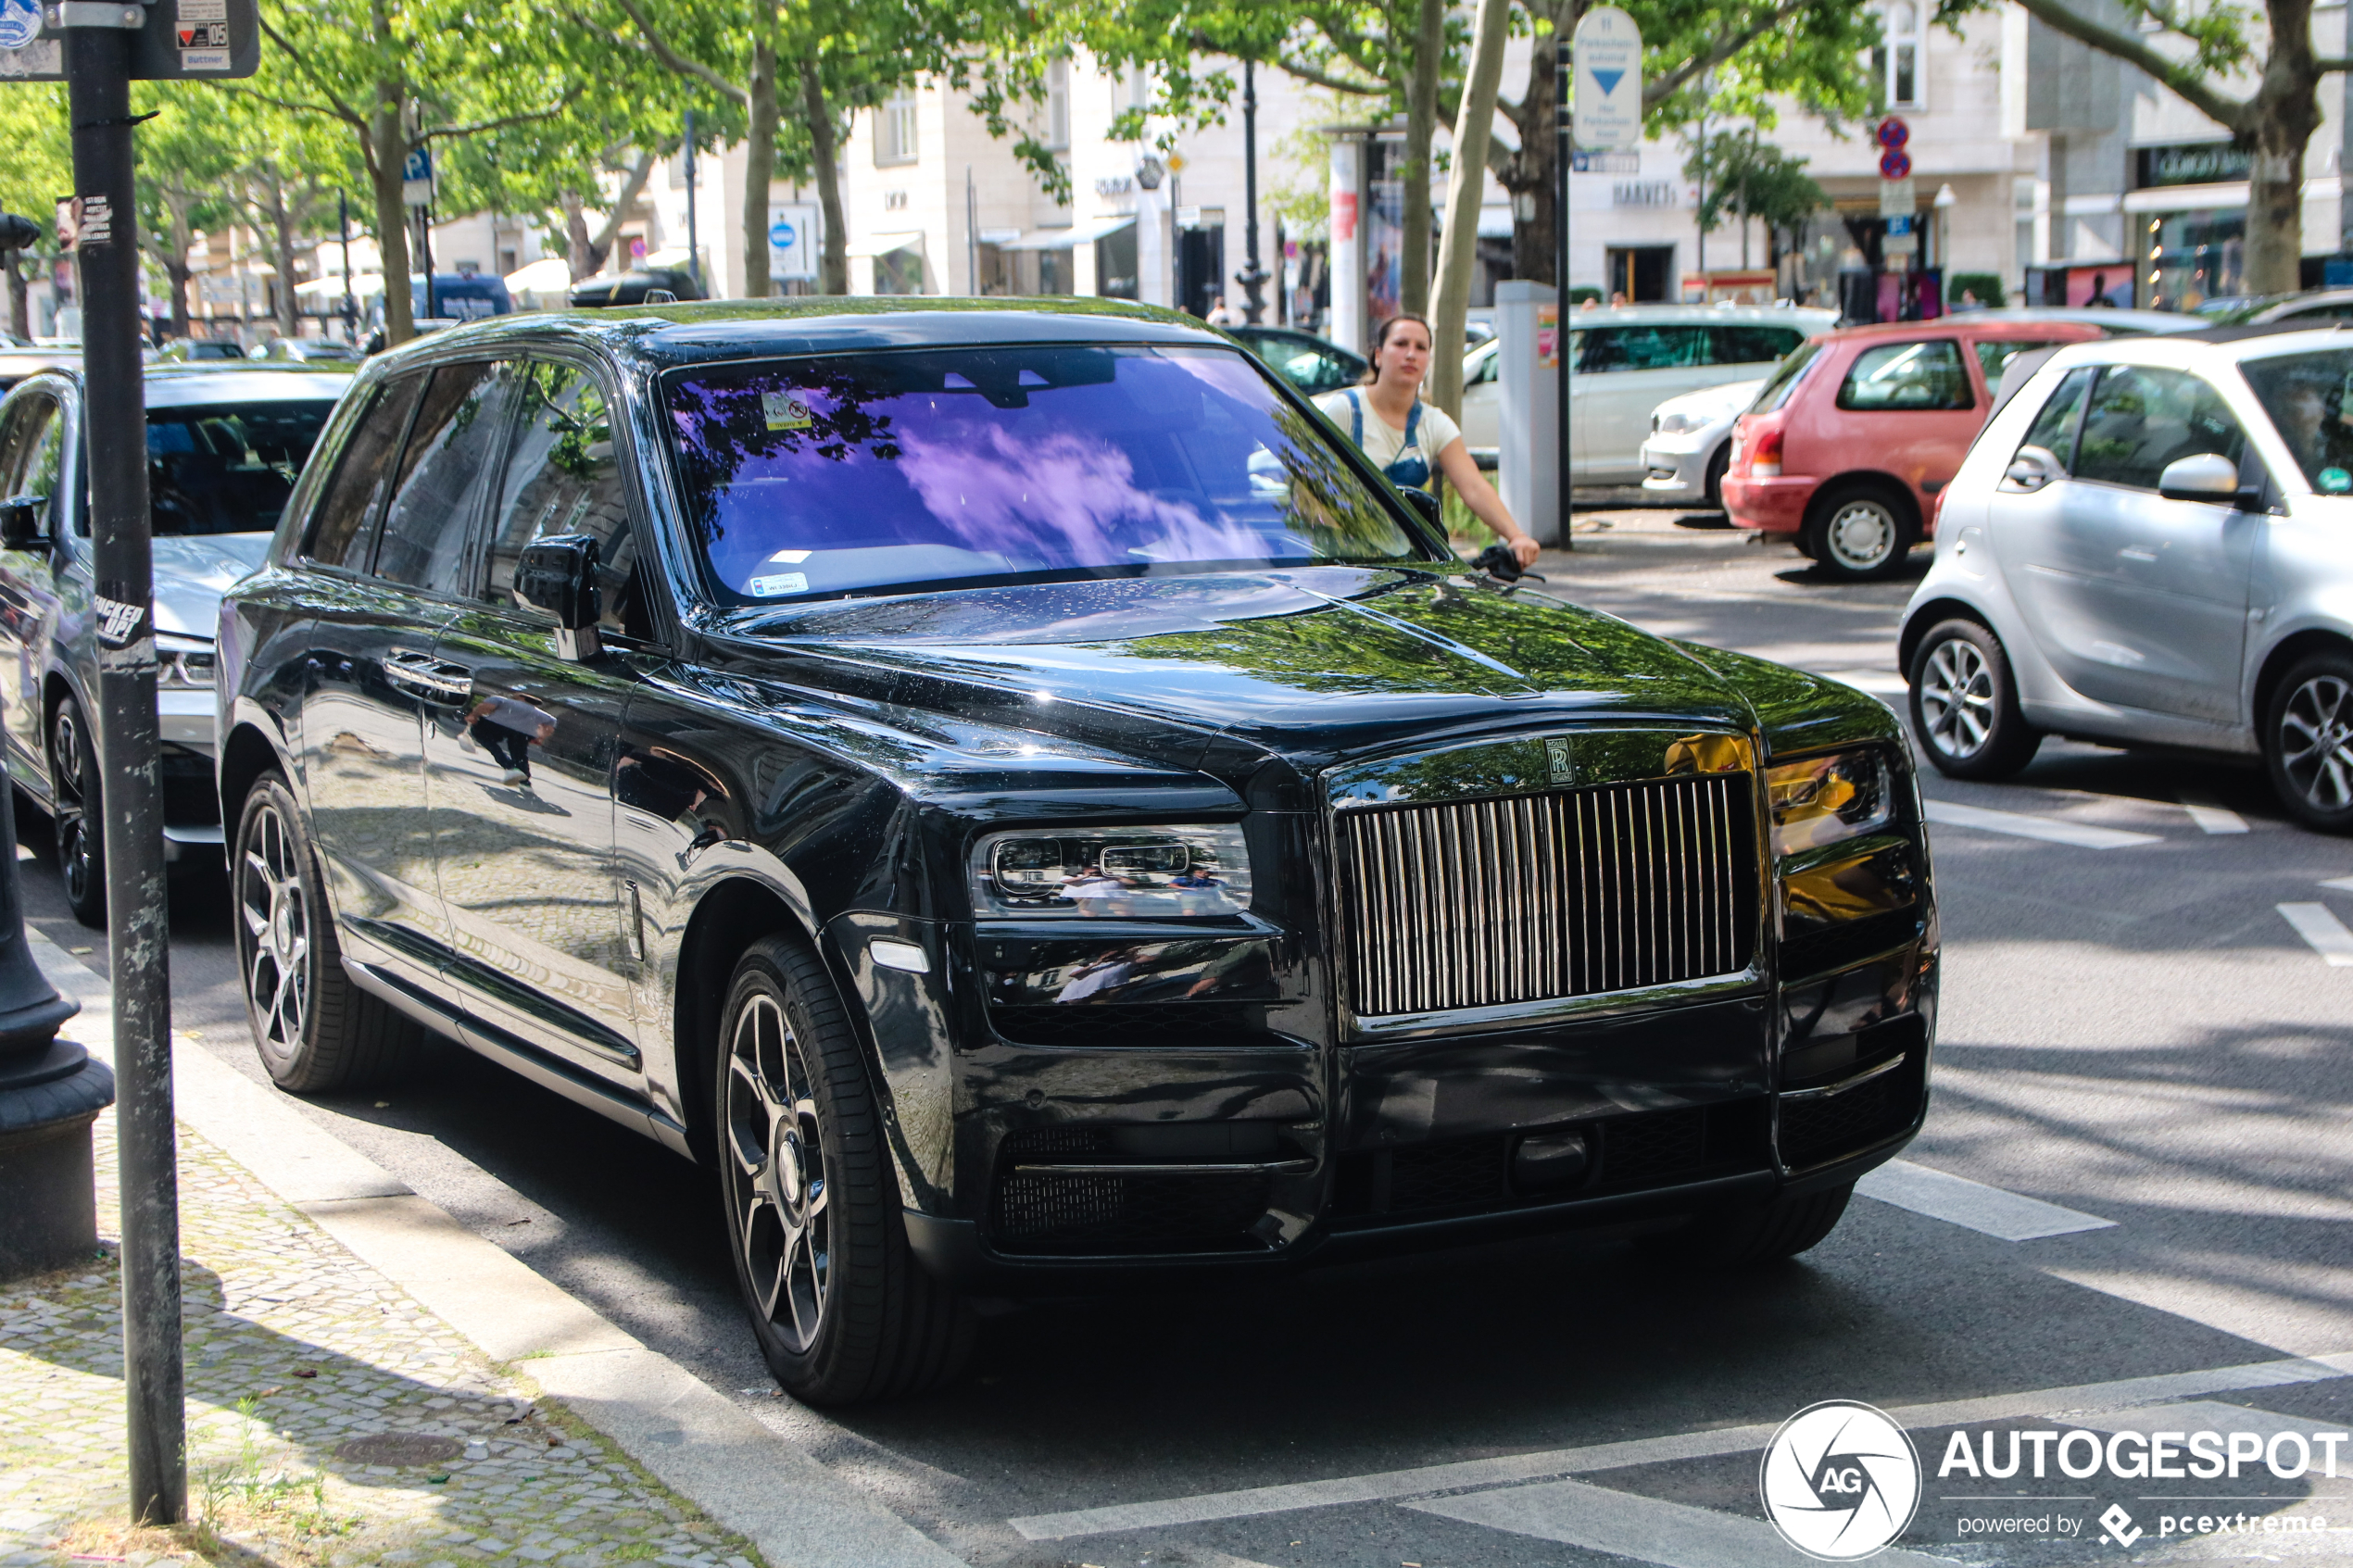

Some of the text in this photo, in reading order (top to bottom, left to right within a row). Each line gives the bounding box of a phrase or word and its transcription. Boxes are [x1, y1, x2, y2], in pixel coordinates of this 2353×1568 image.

[210, 23, 227, 44] 05
[94, 594, 145, 623] FUCKED
[103, 616, 136, 638] UP!
